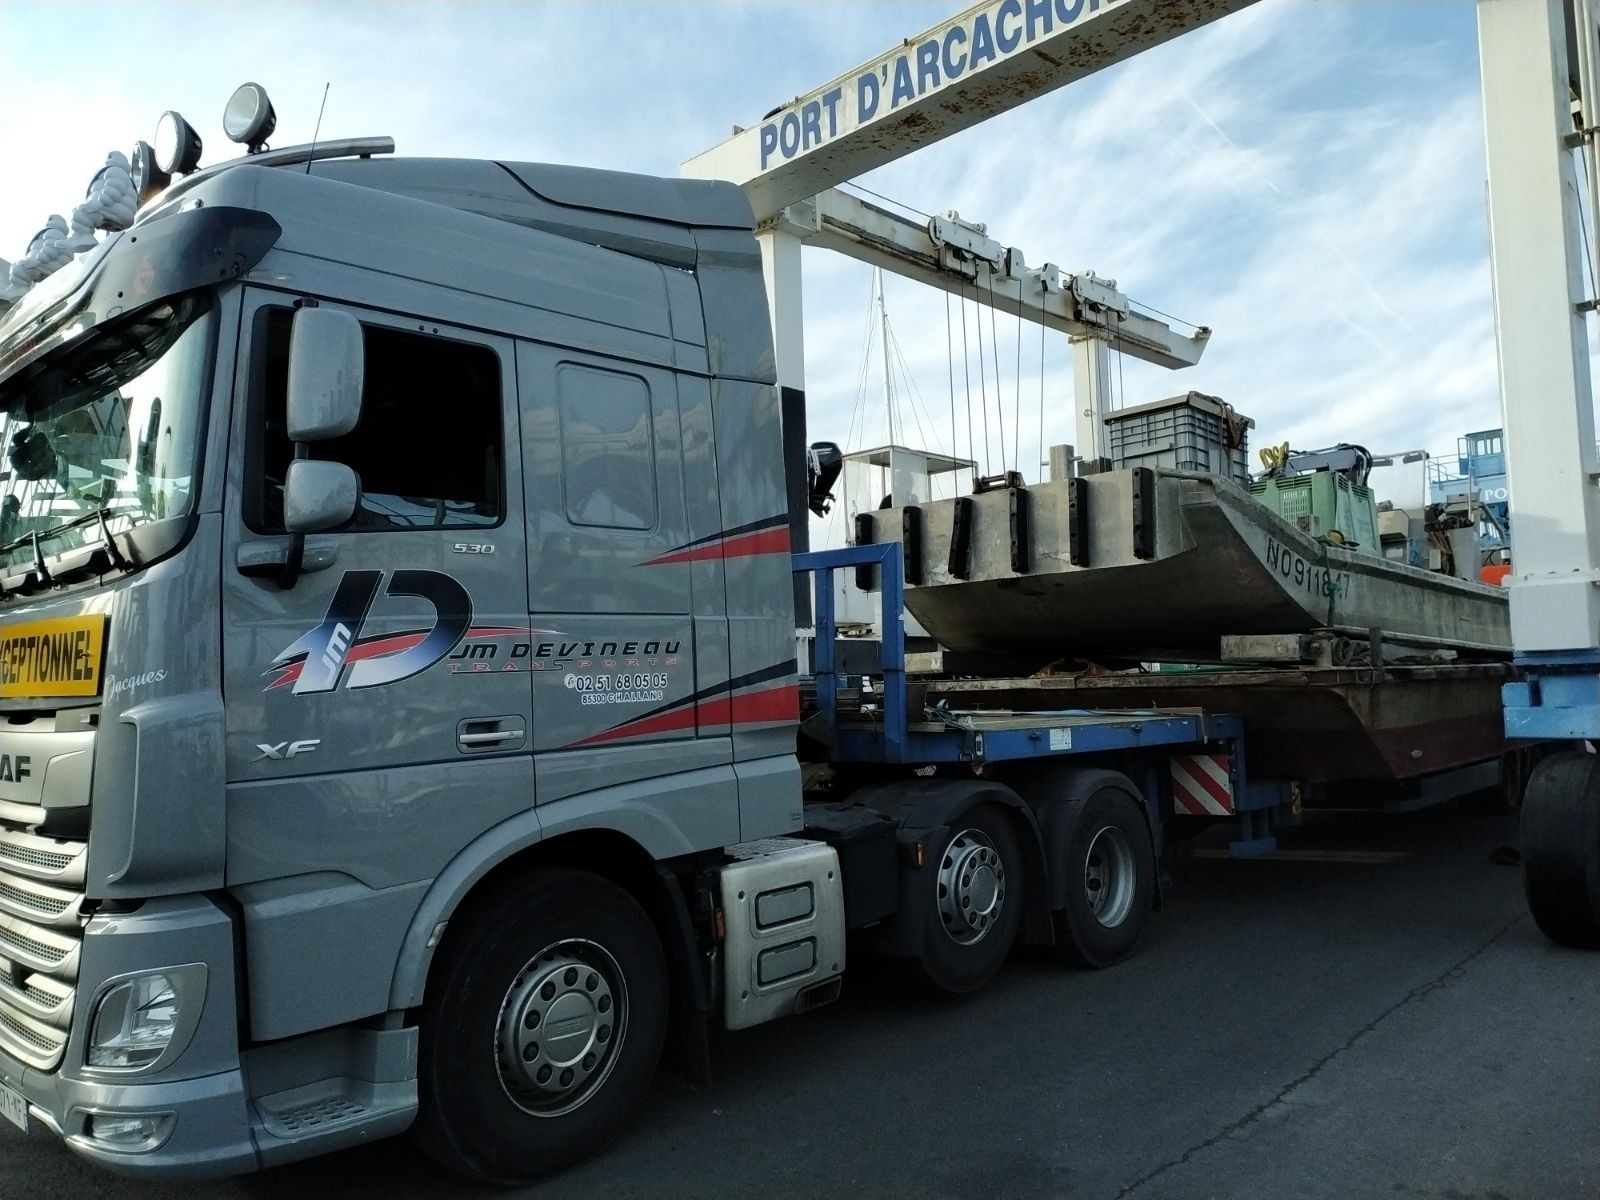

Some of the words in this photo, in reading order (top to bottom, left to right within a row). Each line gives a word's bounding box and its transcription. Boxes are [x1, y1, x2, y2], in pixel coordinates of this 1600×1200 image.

[759, 87, 843, 171] PORT
[857, 0, 1114, 124] D'ARCACHO
[453, 543, 496, 554] 530
[447, 656, 679, 676] TRANSPORTS
[104, 668, 168, 703] Jacques
[607, 690, 664, 703] CHALLANS
[251, 739, 321, 761] XF
